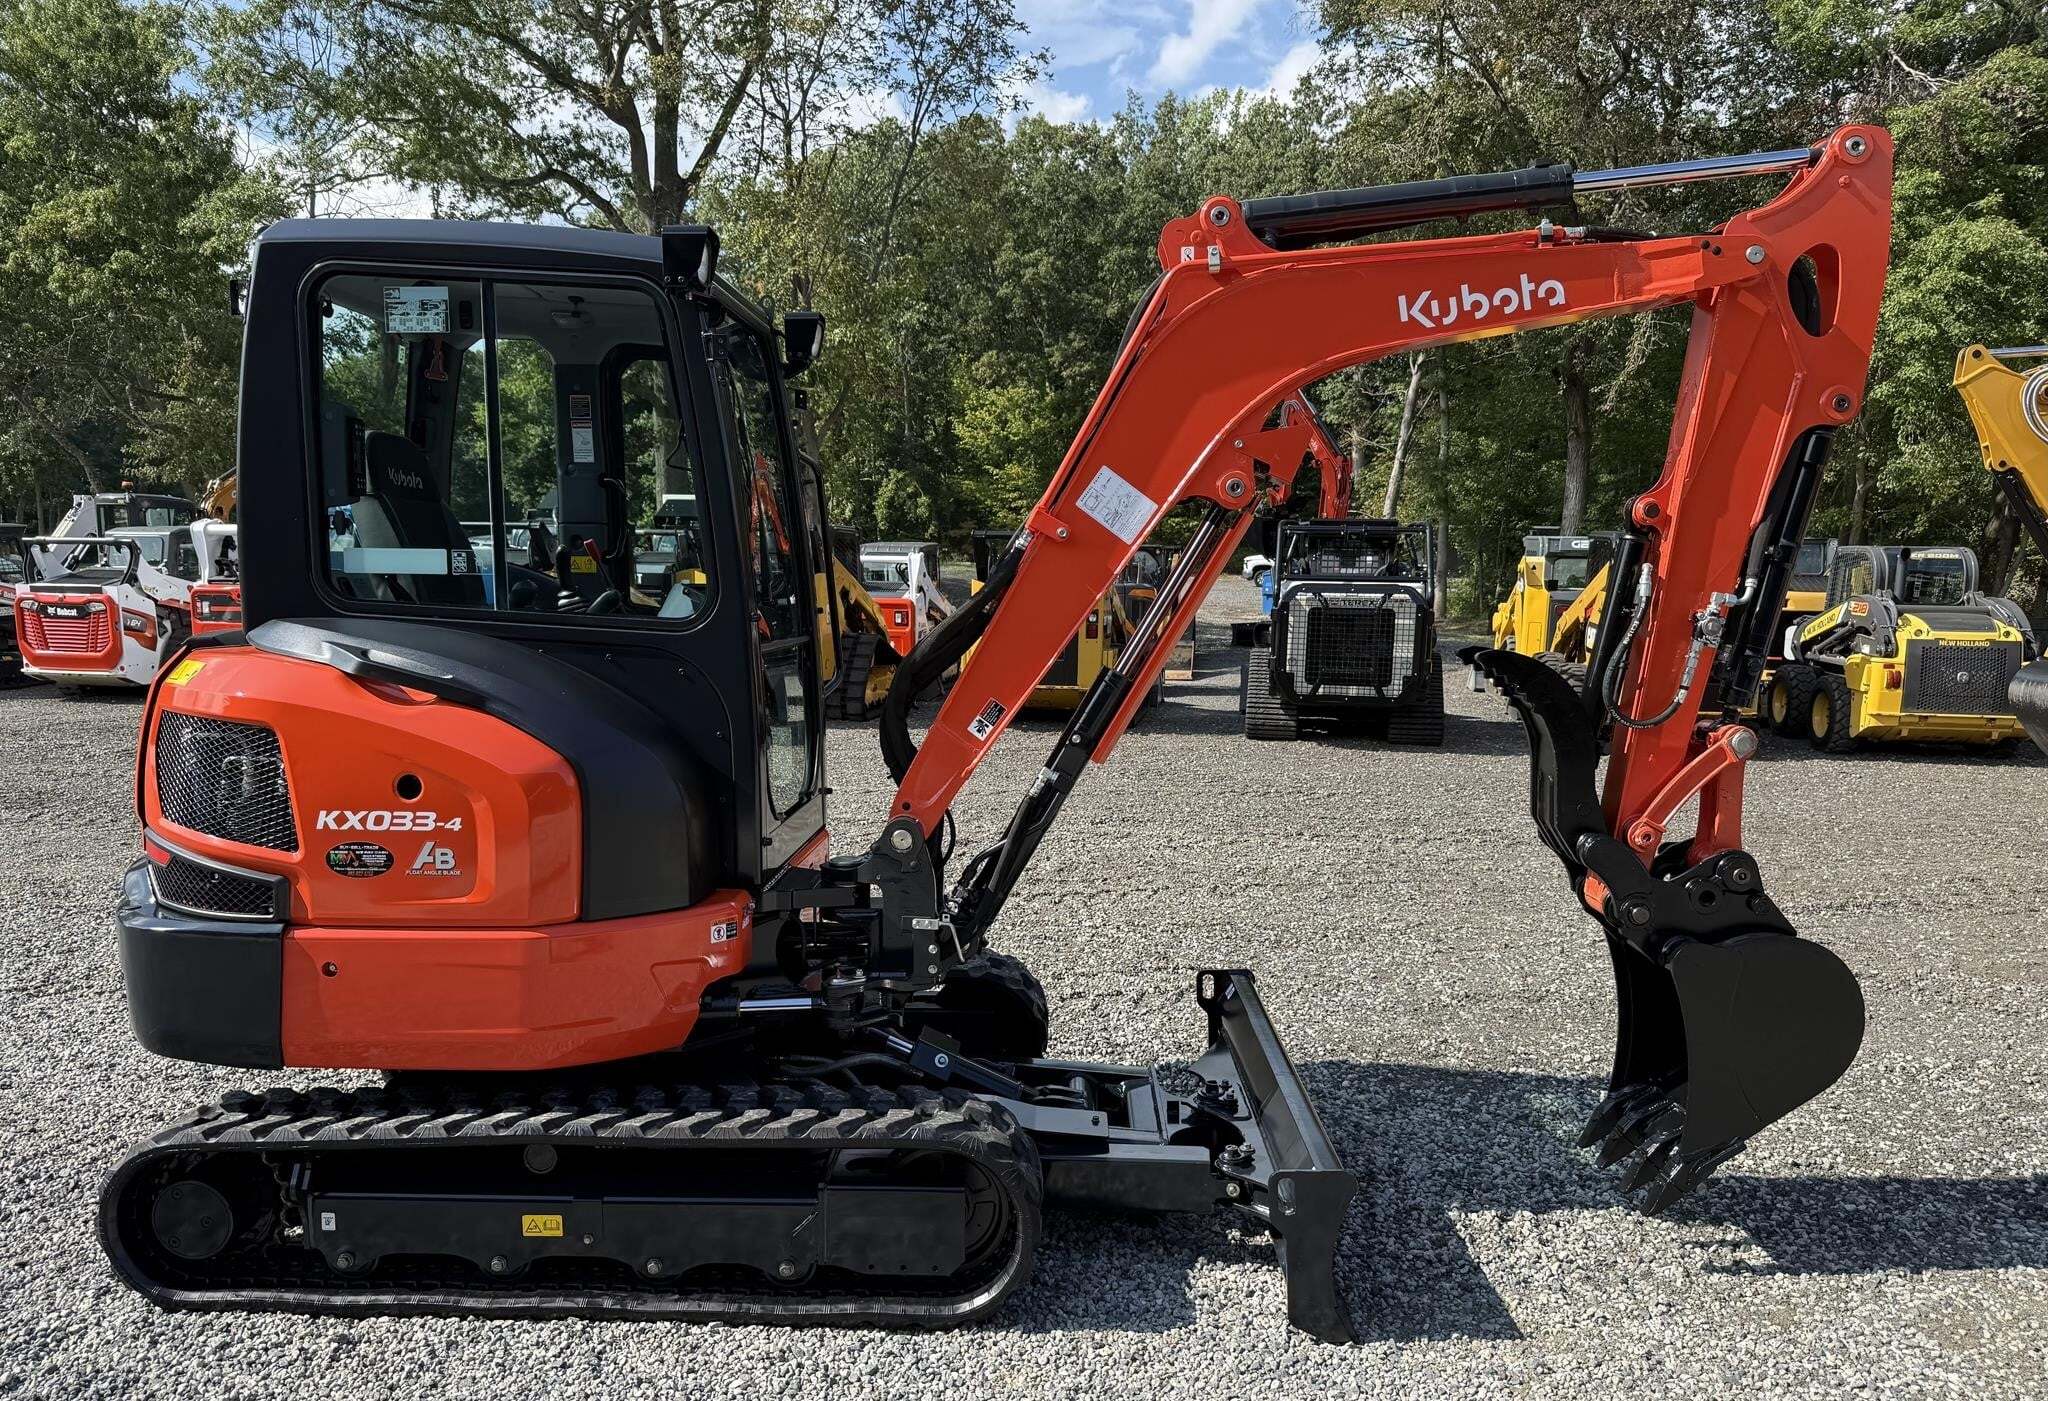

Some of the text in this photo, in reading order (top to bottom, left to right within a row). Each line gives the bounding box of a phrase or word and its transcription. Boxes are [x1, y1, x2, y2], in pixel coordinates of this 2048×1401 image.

[1398, 273, 1566, 328] Kubota
[388, 466, 424, 489] Kubota
[56, 608, 79, 616] Bobcat
[316, 810, 462, 831] KX033-4
